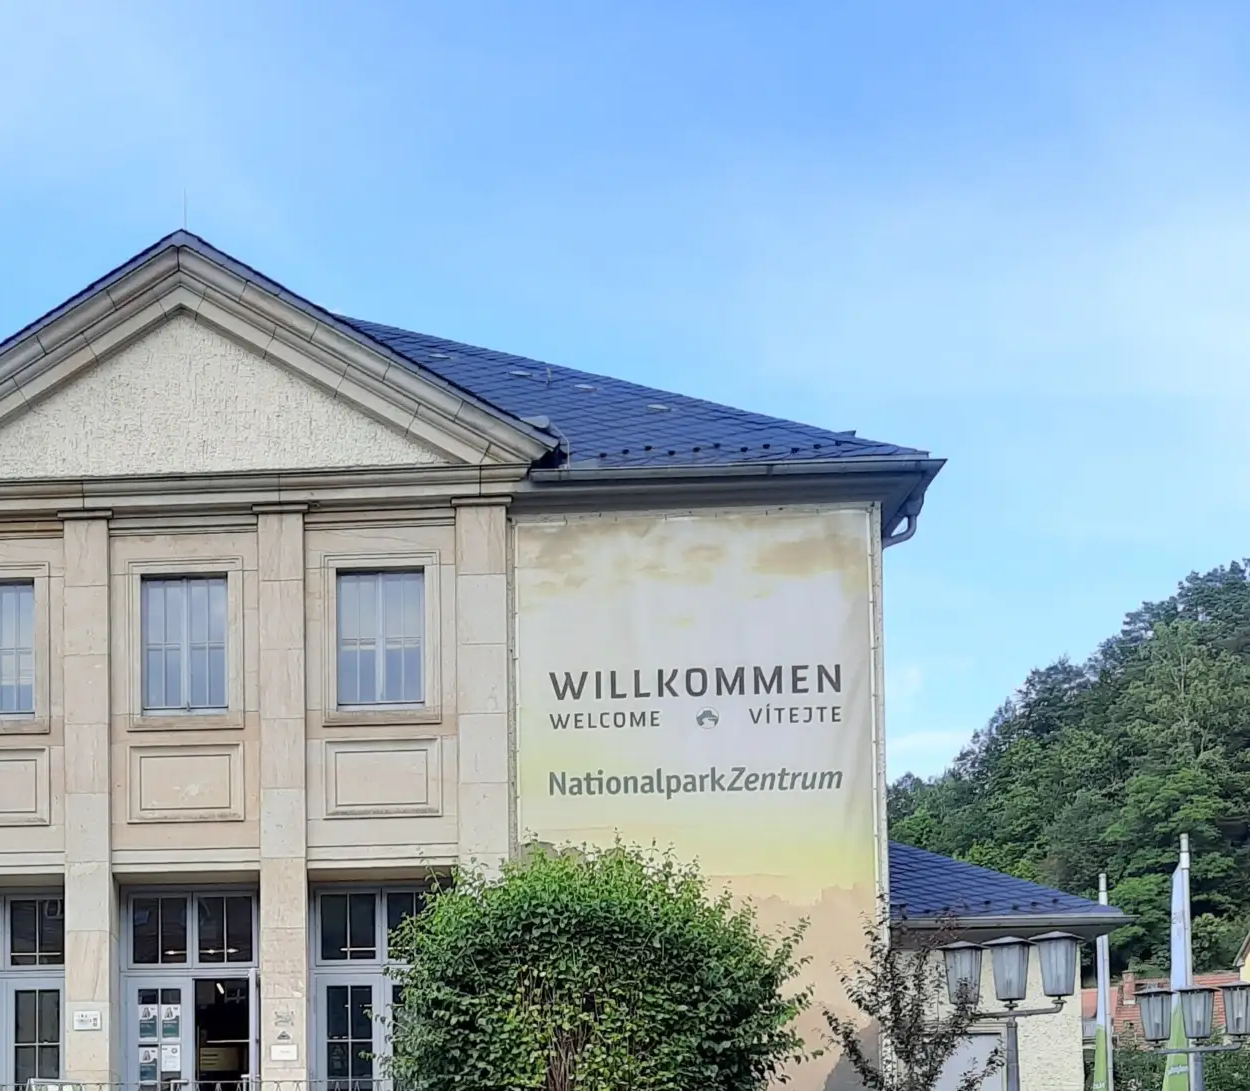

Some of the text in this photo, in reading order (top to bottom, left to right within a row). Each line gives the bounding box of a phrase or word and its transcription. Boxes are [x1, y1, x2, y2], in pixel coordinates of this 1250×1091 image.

[549, 663, 842, 701] WILLKOMMEN
[549, 703, 842, 730] WELCOME VÍTEJTE
[548, 766, 844, 800] NationalparkZentrum
